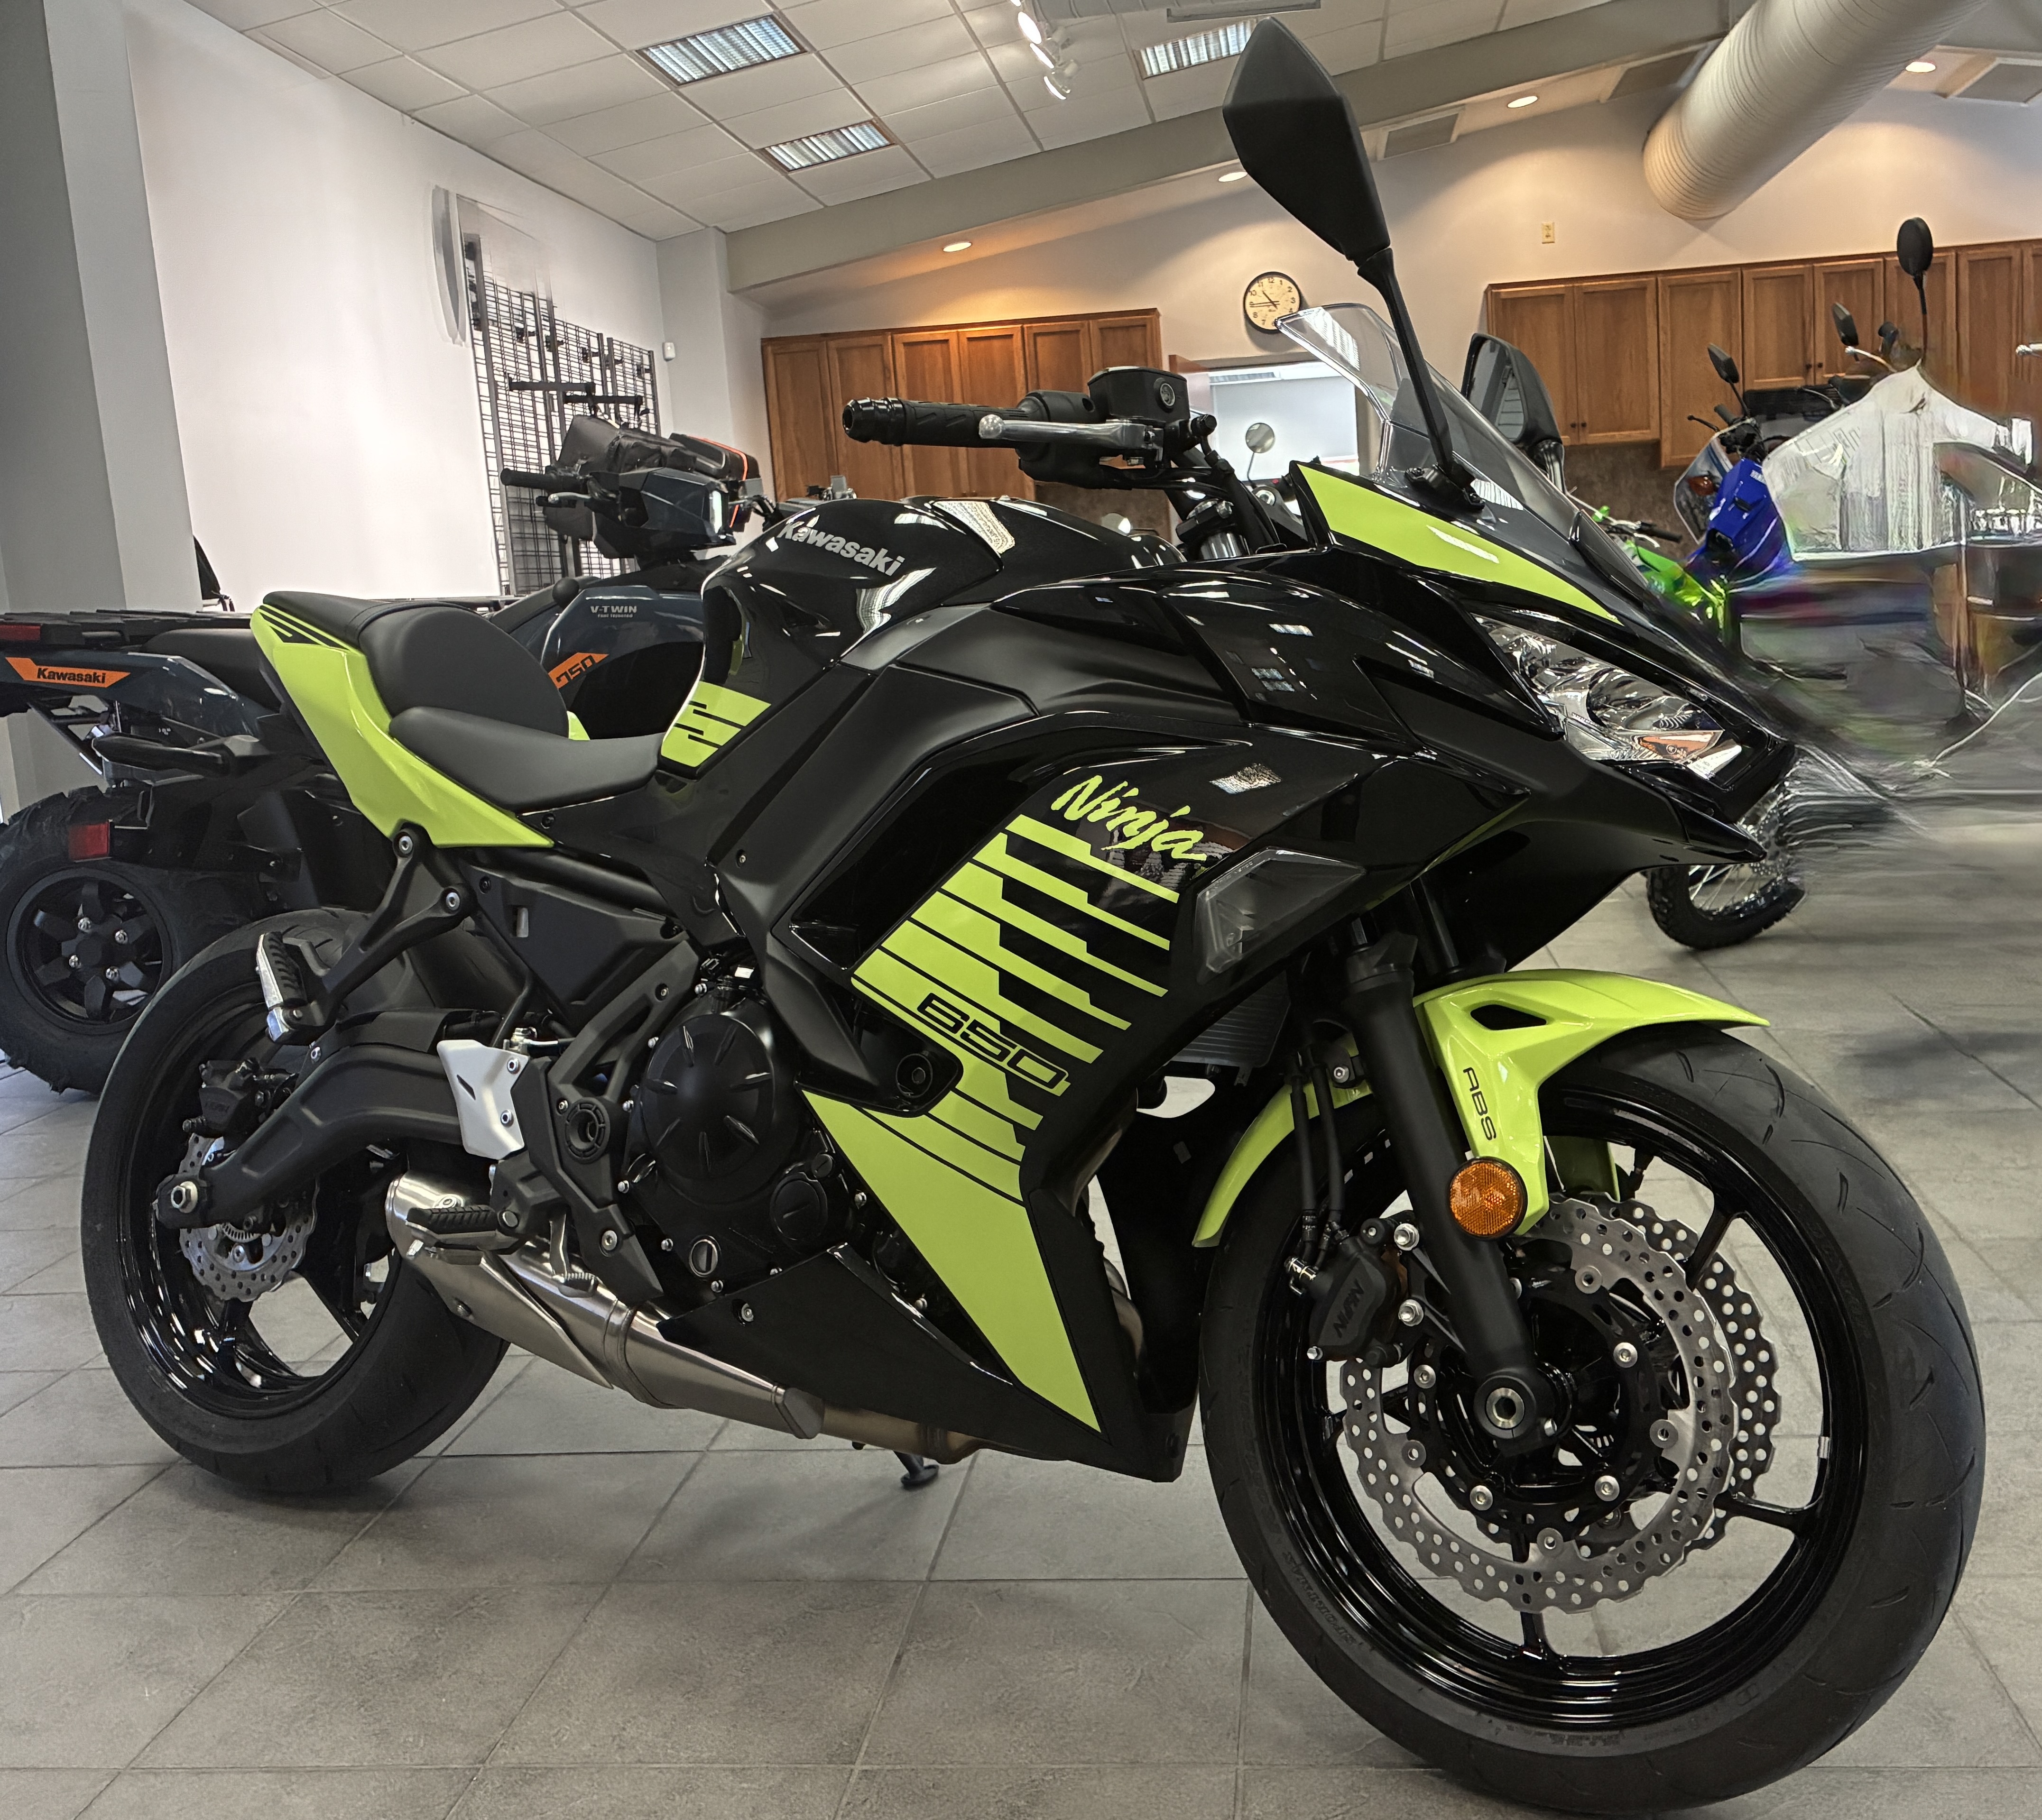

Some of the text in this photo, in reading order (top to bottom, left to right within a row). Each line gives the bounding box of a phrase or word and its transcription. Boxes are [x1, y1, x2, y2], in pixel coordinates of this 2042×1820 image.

[777, 522, 905, 576] Kawasaki
[37, 668, 106, 684] Kawasaki
[555, 655, 594, 683] 750
[1051, 775, 1208, 861] Ninja
[917, 993, 1067, 1090] 650
[1463, 1067, 1497, 1140] ABS
